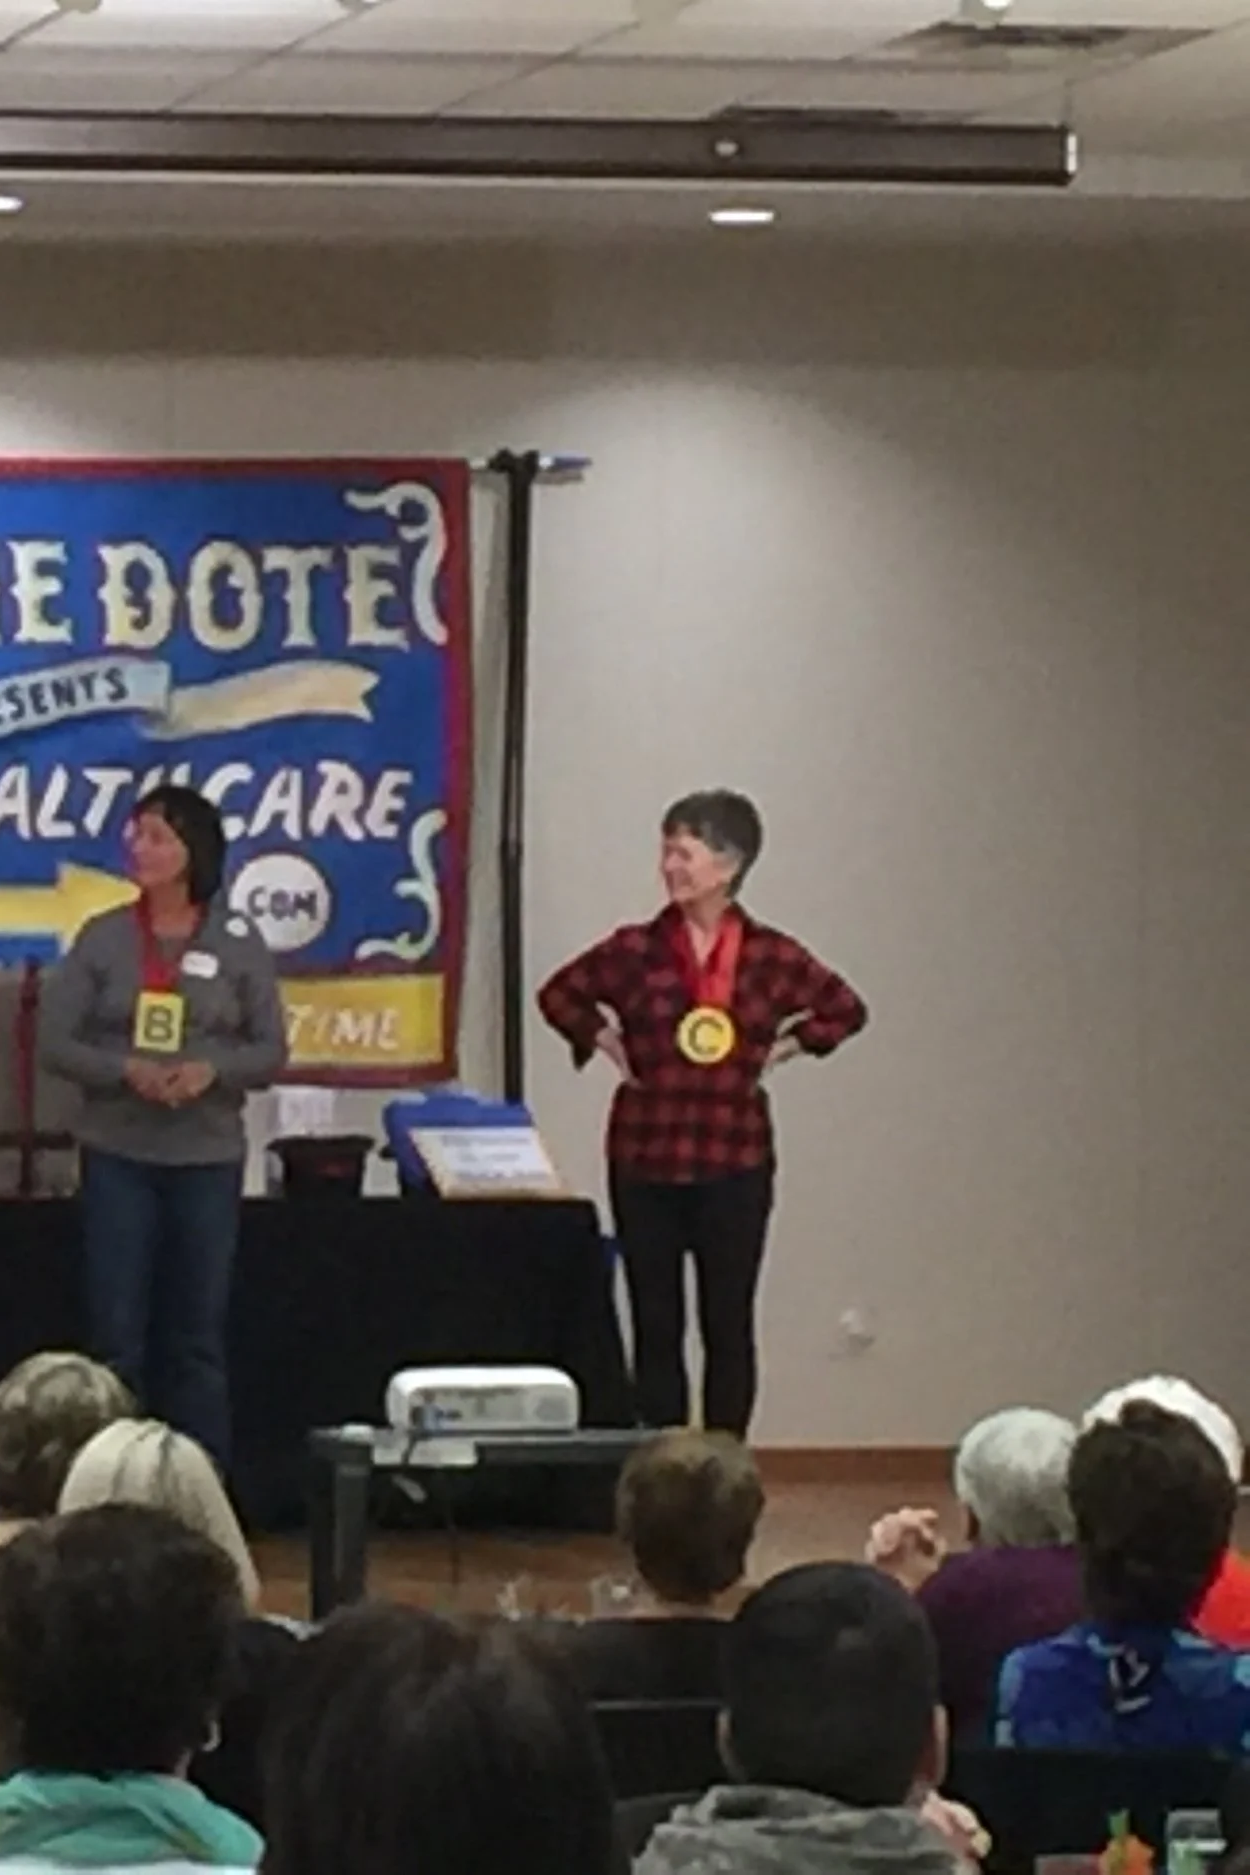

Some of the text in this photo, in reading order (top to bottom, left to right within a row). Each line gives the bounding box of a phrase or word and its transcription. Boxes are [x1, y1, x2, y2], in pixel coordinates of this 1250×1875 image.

[97, 540, 410, 652] DOTE
[145, 1004, 172, 1042] B
[286, 1003, 399, 1050] TIME
[688, 1016, 724, 1055] C
